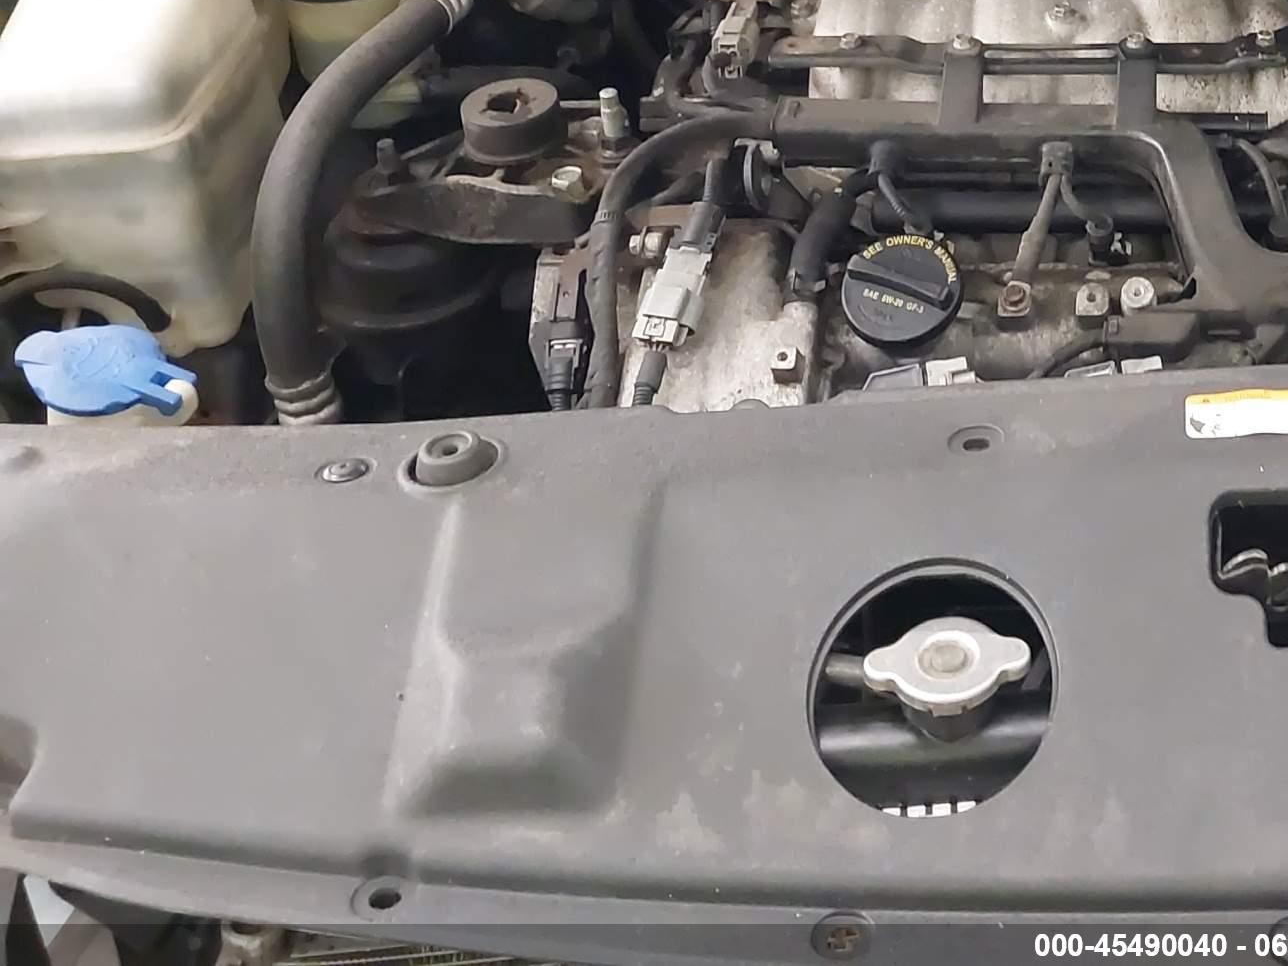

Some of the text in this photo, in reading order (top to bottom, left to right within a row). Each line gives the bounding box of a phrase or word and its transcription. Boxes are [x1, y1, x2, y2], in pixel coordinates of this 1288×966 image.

[863, 235, 957, 286] SEE OWNER'S MANUAL
[863, 288, 880, 301] SAE
